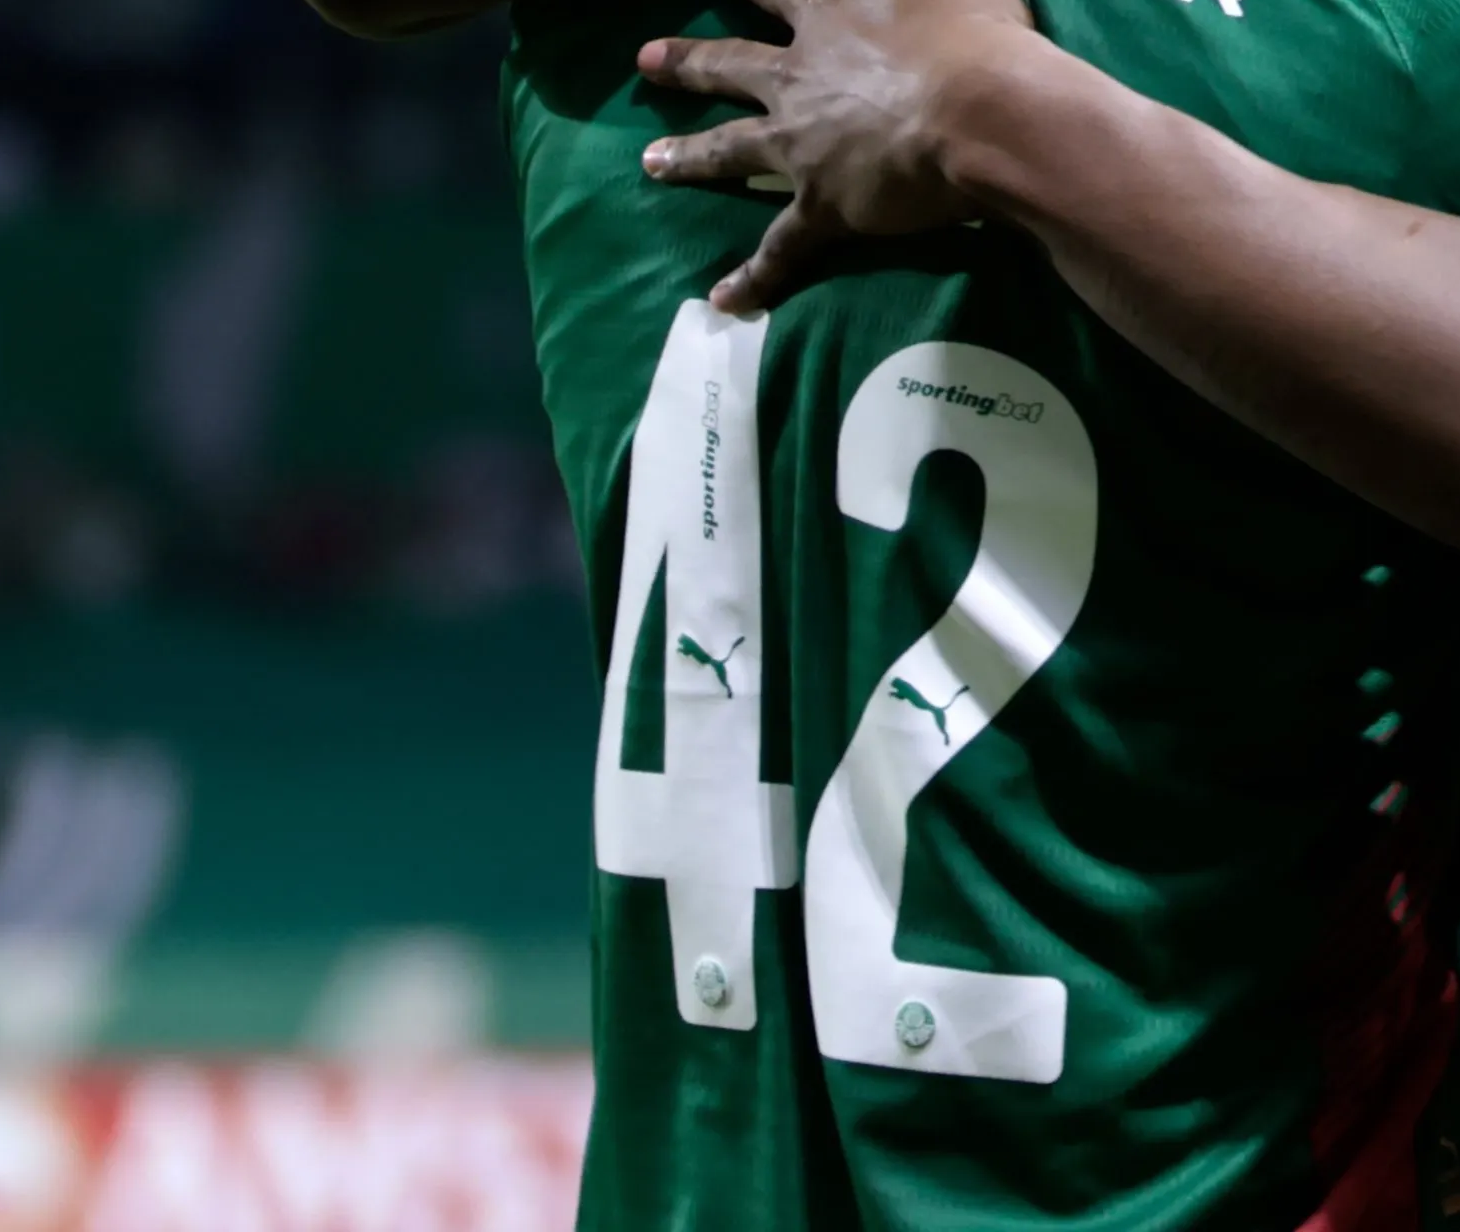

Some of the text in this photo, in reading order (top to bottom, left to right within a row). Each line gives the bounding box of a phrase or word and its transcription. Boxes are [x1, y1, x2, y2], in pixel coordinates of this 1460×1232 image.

[700, 380, 721, 541] sportingbet
[897, 376, 1045, 424] sportingbet
[593, 298, 1099, 1084] 42
